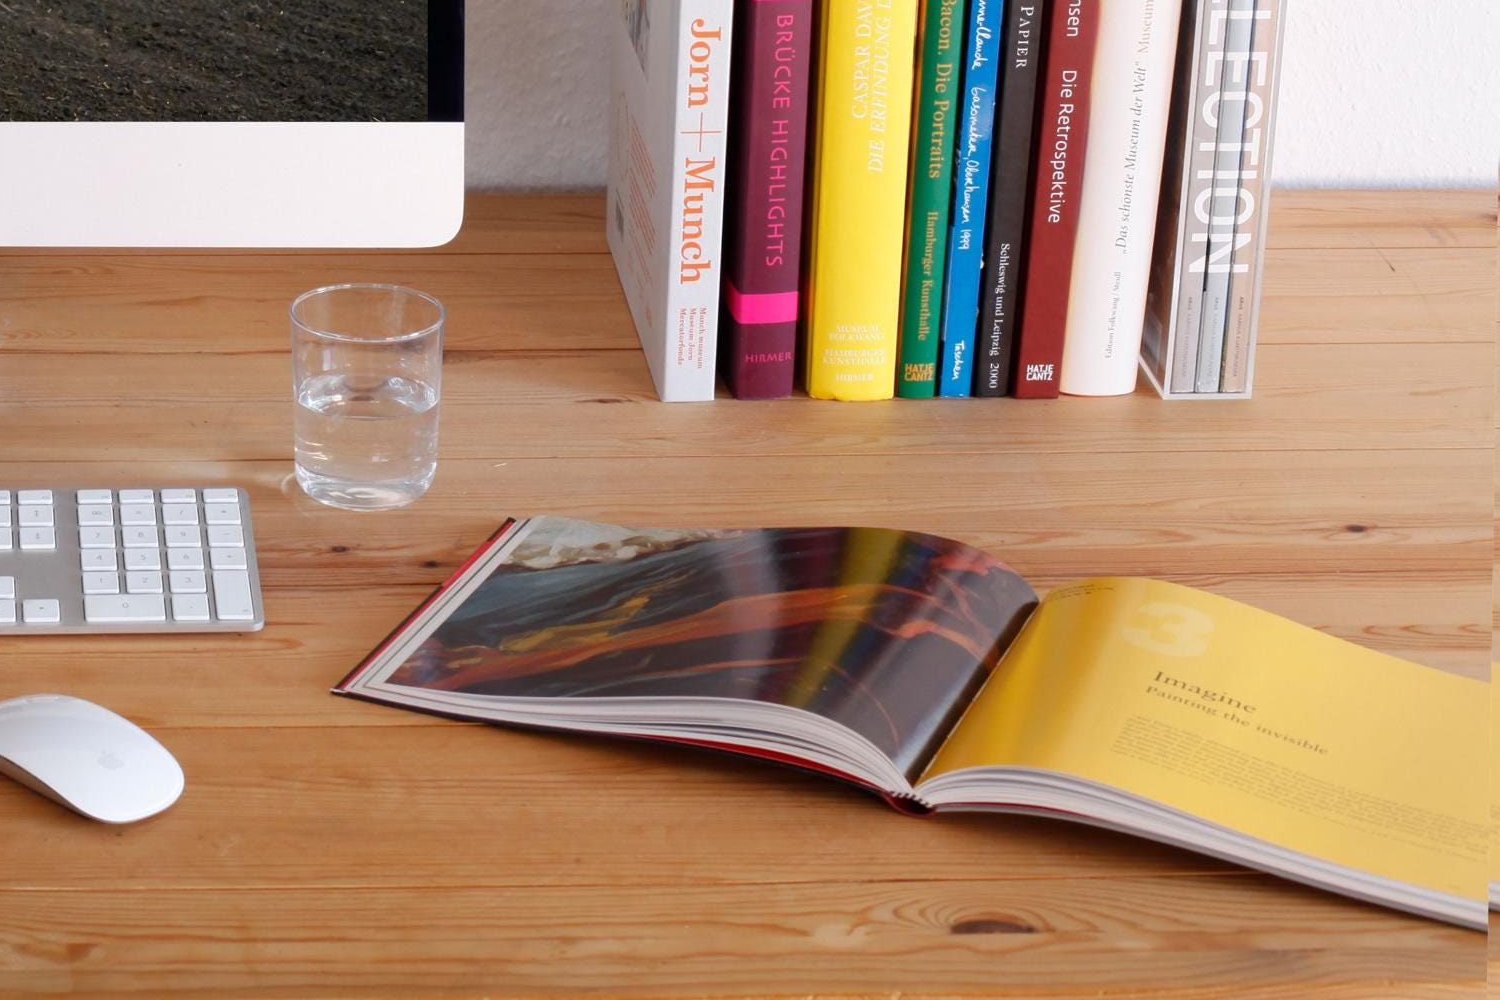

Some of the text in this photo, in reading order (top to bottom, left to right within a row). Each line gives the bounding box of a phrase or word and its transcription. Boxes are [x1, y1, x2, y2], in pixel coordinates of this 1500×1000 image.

[1015, 5, 1035, 69] PAPIER
[1137, 0, 1155, 54] Museum
[687, 18, 722, 109] Jorn
[852, 45, 872, 120] CASPAR
[870, 16, 893, 134] ERFINDUNG
[935, 63, 953, 94] Die
[1060, 69, 1078, 99] Die
[1130, 96, 1142, 117] der
[766, 14, 794, 267] BRÜCKE HIGHLIGHTS
[867, 141, 884, 174] DIE
[928, 98, 950, 179] Portraits
[1047, 102, 1074, 224] Retrospektive
[1124, 119, 1141, 171] Museum
[680, 156, 716, 285] Munch
[917, 211, 938, 341] Hamburger Kunsthalle
[989, 243, 1011, 389] Schleswig und Leipzig 2000
[745, 351, 793, 364] HIRMER
[904, 372, 934, 382] CANTZ
[905, 363, 935, 373] HATJE
[1026, 364, 1054, 374] HATJE
[1026, 372, 1053, 381] CANTZ
[1121, 601, 1216, 659] 3
[1145, 685, 1329, 755] Painting the invisible
[1153, 670, 1257, 714] Imagine
